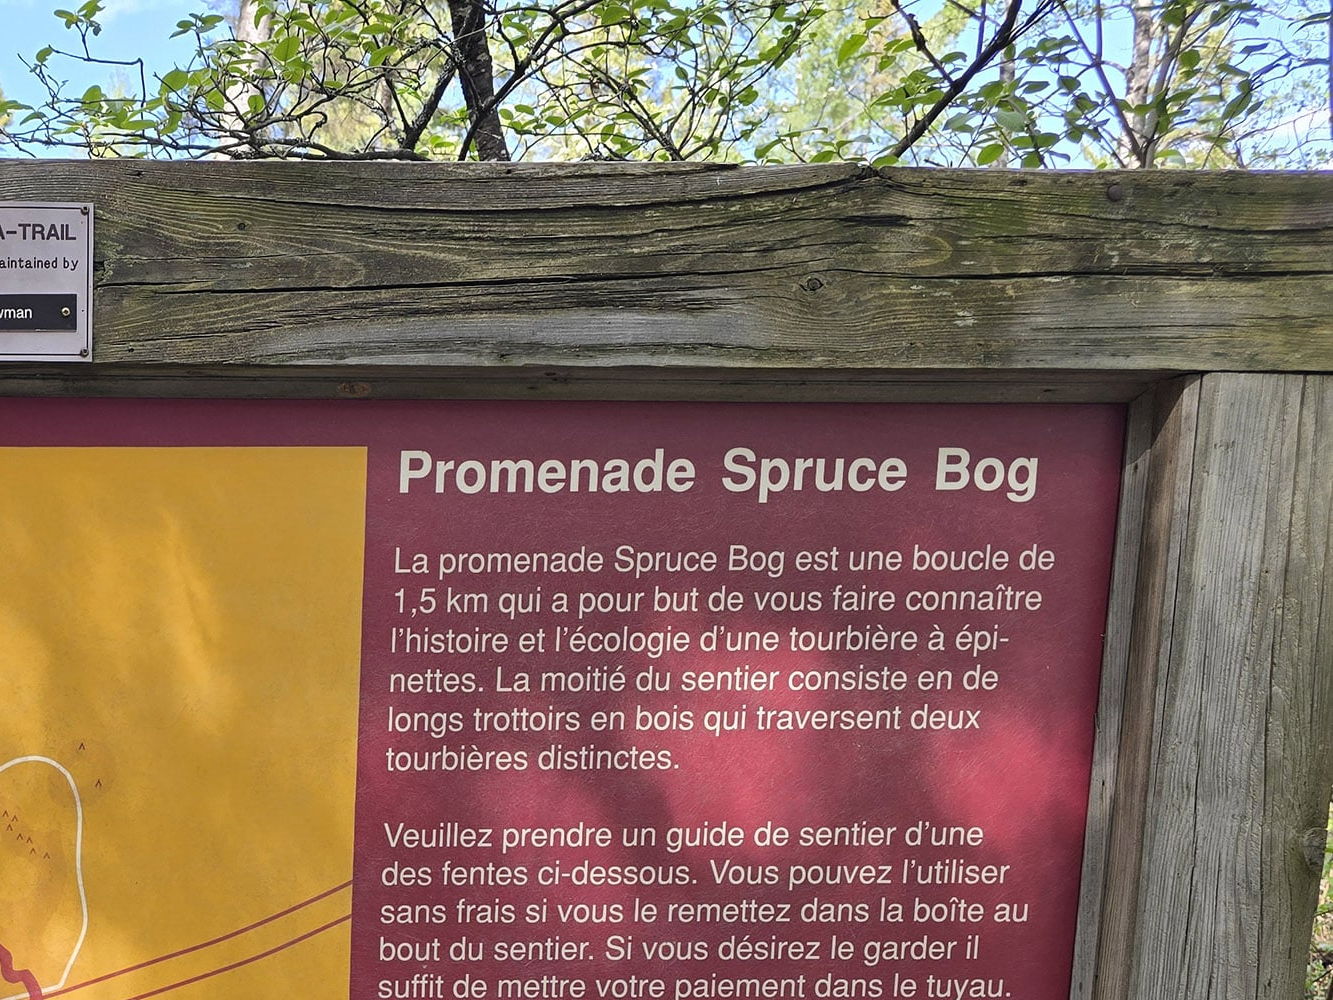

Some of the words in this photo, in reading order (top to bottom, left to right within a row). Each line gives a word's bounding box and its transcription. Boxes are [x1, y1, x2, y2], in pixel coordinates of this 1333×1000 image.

[63, 257, 79, 271] by
[399, 448, 695, 494] Promenade
[722, 447, 907, 503] Spruce
[935, 447, 1038, 502] Bog
[395, 547, 429, 573] La
[439, 546, 603, 580] promenade
[614, 545, 717, 579] Spruce
[729, 545, 785, 578] Bog
[795, 546, 839, 571] est
[849, 551, 902, 571] une
[913, 544, 1009, 571] boucle
[1019, 543, 1055, 570] de
[378, 974, 444, 998] suffit
[453, 974, 487, 998] de
[498, 975, 586, 998] mettre
[596, 975, 665, 998] votre
[815, 973, 883, 997] dans
[894, 973, 917, 997] le
